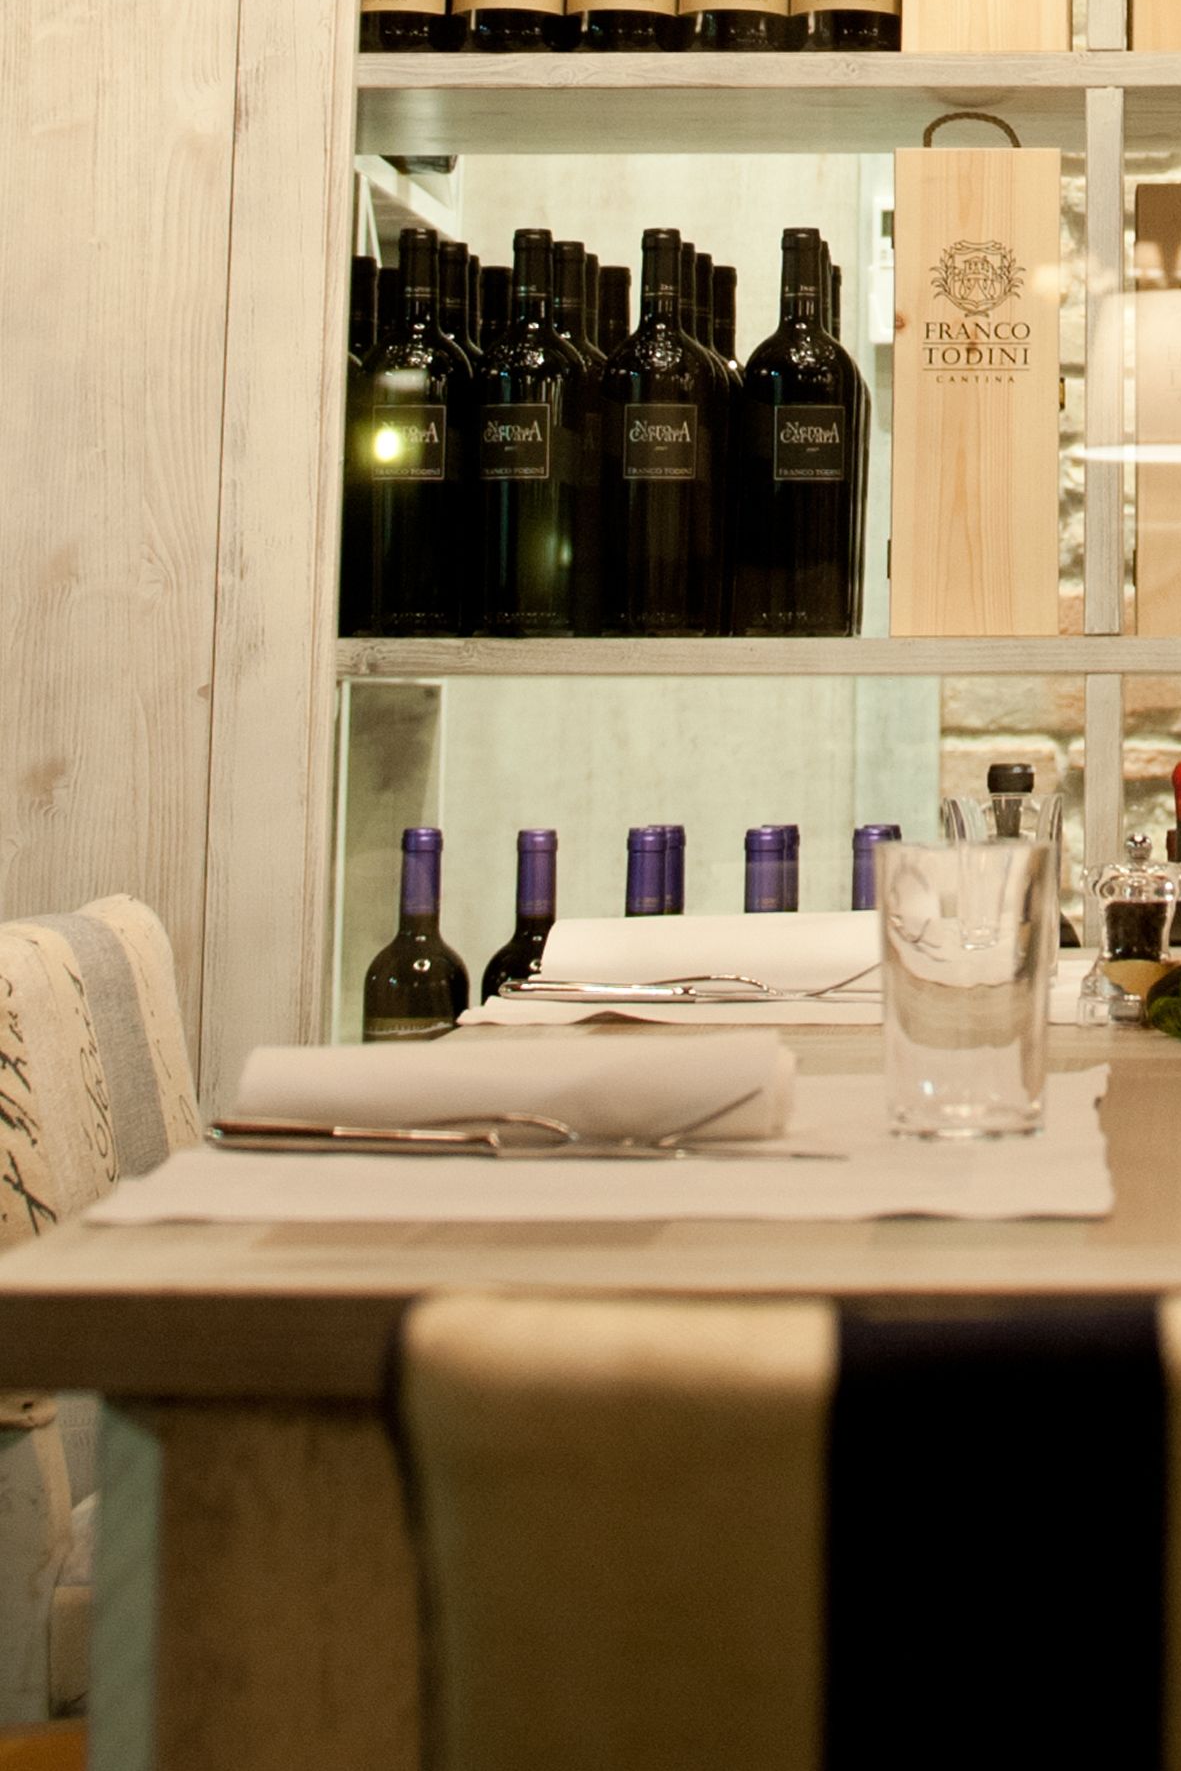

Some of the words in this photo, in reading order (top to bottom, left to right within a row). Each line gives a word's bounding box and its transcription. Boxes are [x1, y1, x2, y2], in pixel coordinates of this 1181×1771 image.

[924, 322, 1031, 340] FRANCO
[922, 347, 1031, 365] TODINI
[936, 375, 1015, 384] CANTINA
[634, 419, 672, 435] Nero
[785, 420, 823, 435] Nero
[627, 467, 663, 476] FRANCO
[778, 468, 814, 477] FRANCO
